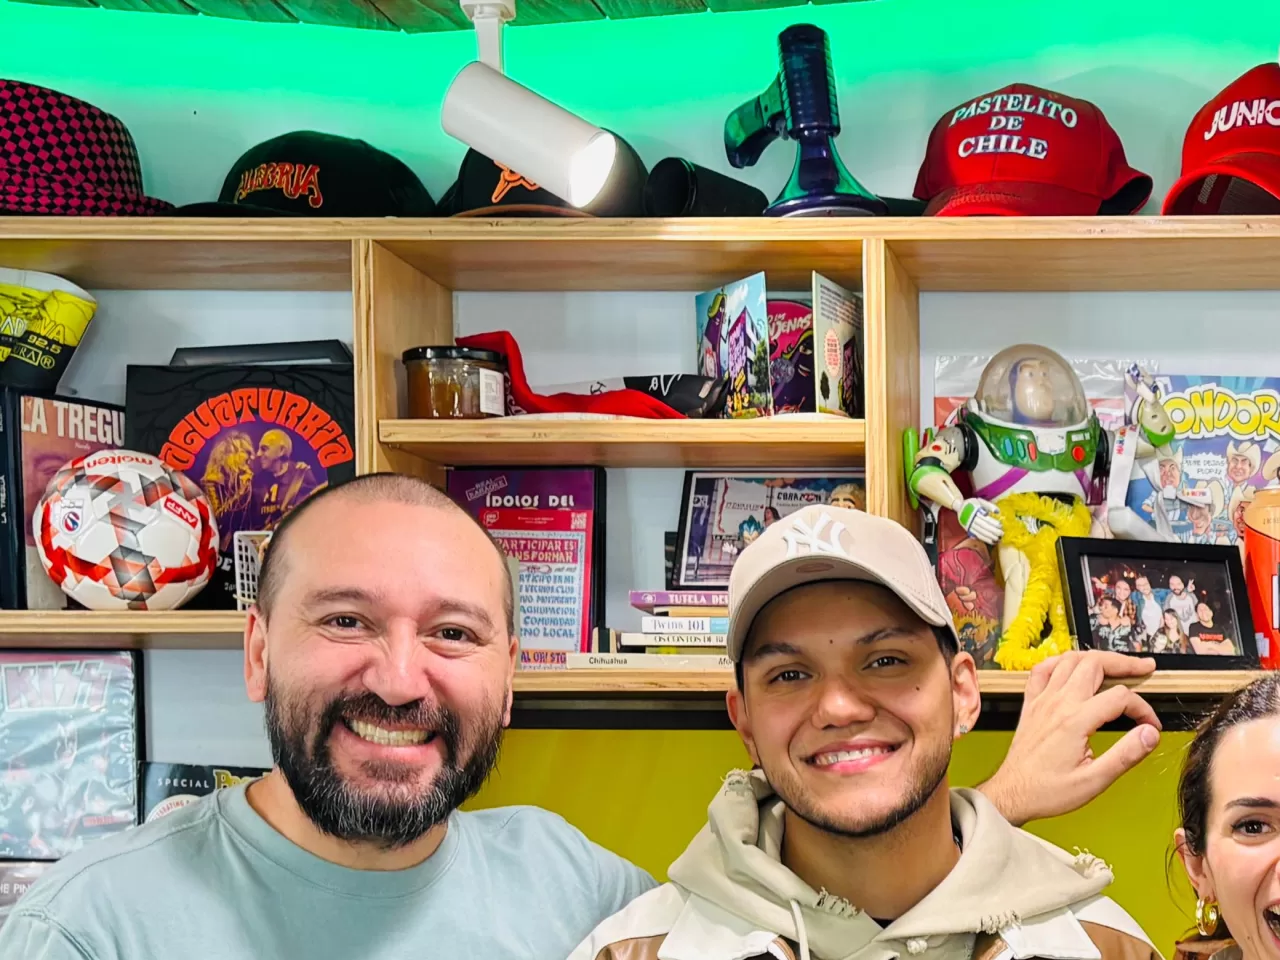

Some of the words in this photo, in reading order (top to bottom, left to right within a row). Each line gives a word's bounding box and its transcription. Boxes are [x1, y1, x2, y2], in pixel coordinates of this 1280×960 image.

[948, 92, 1078, 128] PASTELITO
[987, 115, 1024, 132] DE
[957, 133, 1049, 161] CHILE
[27, 334, 62, 354] 92.5
[20, 395, 47, 434] LA
[53, 400, 125, 447] TREGU
[86, 455, 153, 469] molten
[486, 492, 539, 507] ÍDOLOS
[549, 495, 574, 507] DEL
[504, 551, 573, 562] ANSFORMAR
[668, 594, 706, 604] TUTELA
[543, 627, 574, 638] LOCAL
[688, 620, 704, 631] 101
[589, 657, 628, 665] Chihuahua
[158, 778, 210, 789] SPECIAL
